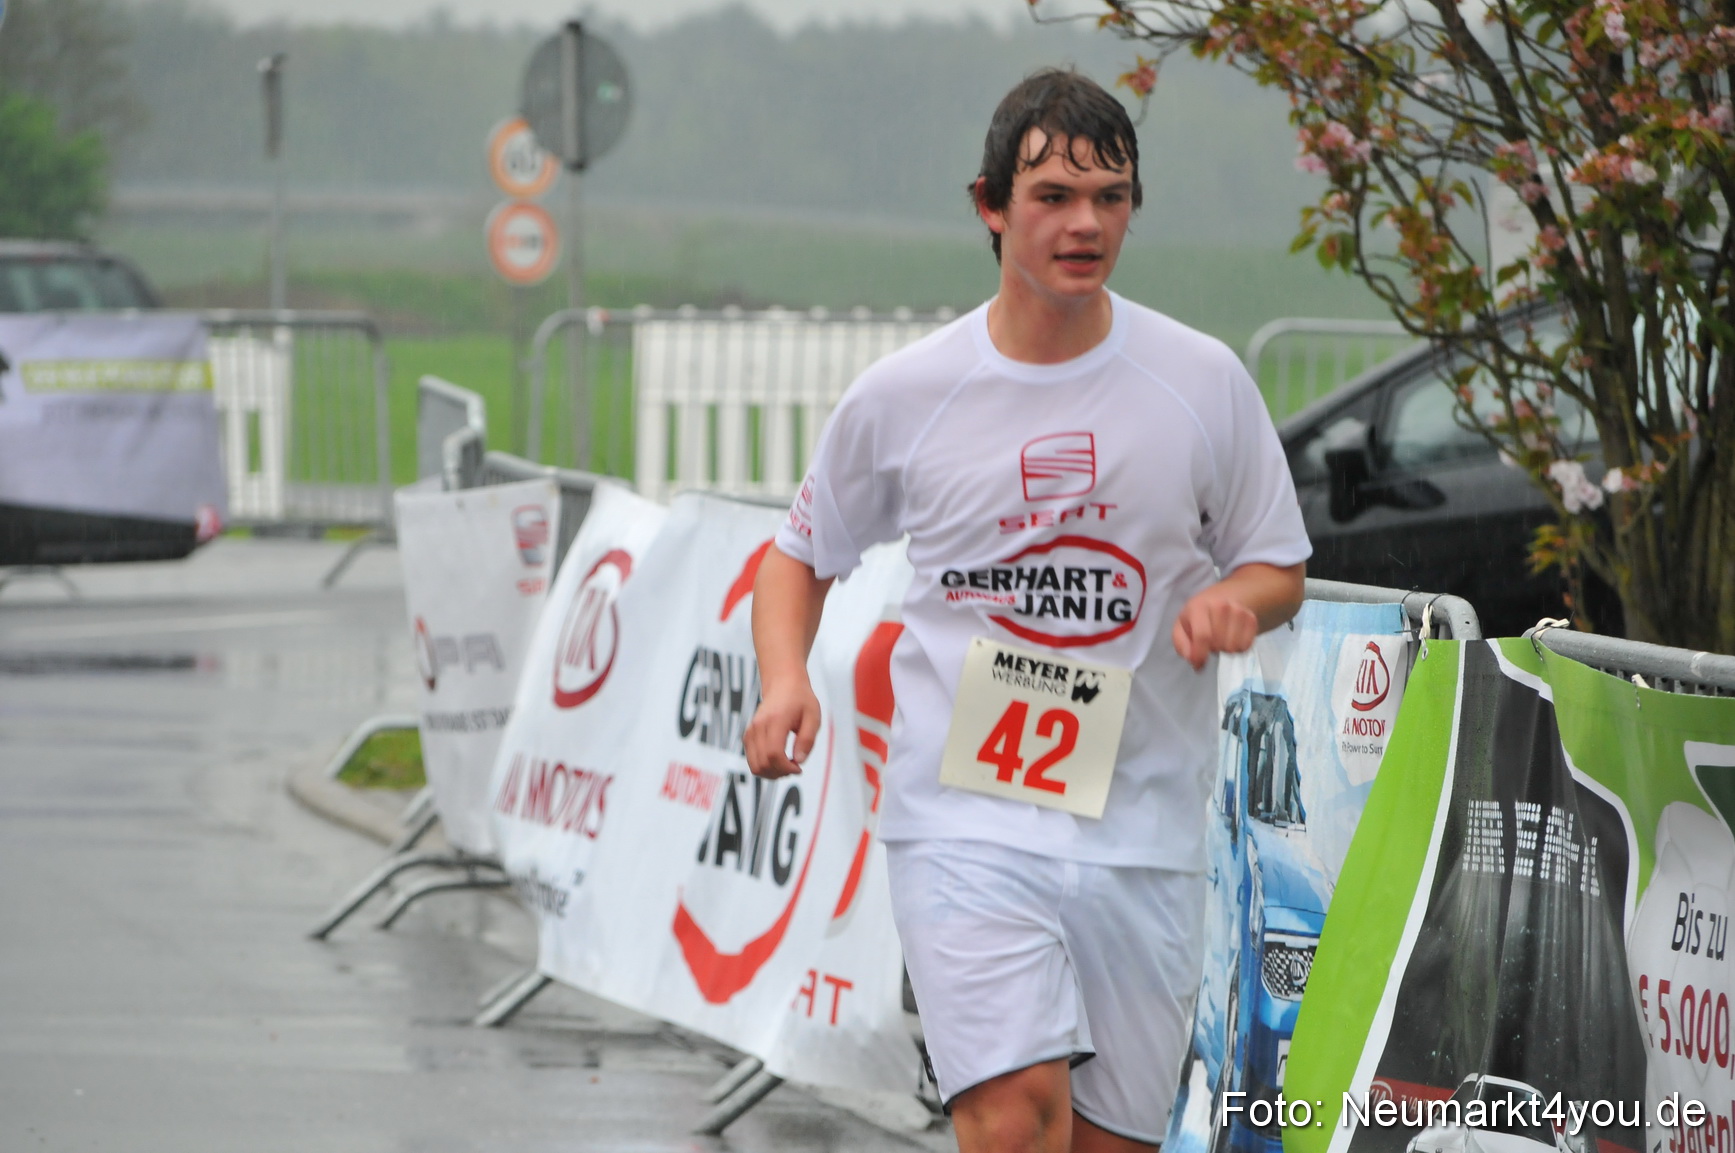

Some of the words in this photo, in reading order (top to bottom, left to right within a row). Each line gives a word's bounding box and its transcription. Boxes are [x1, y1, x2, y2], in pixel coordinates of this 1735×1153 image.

[999, 502, 1118, 534] SEAT
[941, 565, 1112, 593] GERHART
[1112, 571, 1128, 589] &
[991, 667, 1067, 697] WERBUNG
[994, 651, 1070, 683] MEYER
[976, 698, 1080, 797] 42
[1671, 892, 1704, 955] Bis
[1706, 913, 1729, 961] zu
